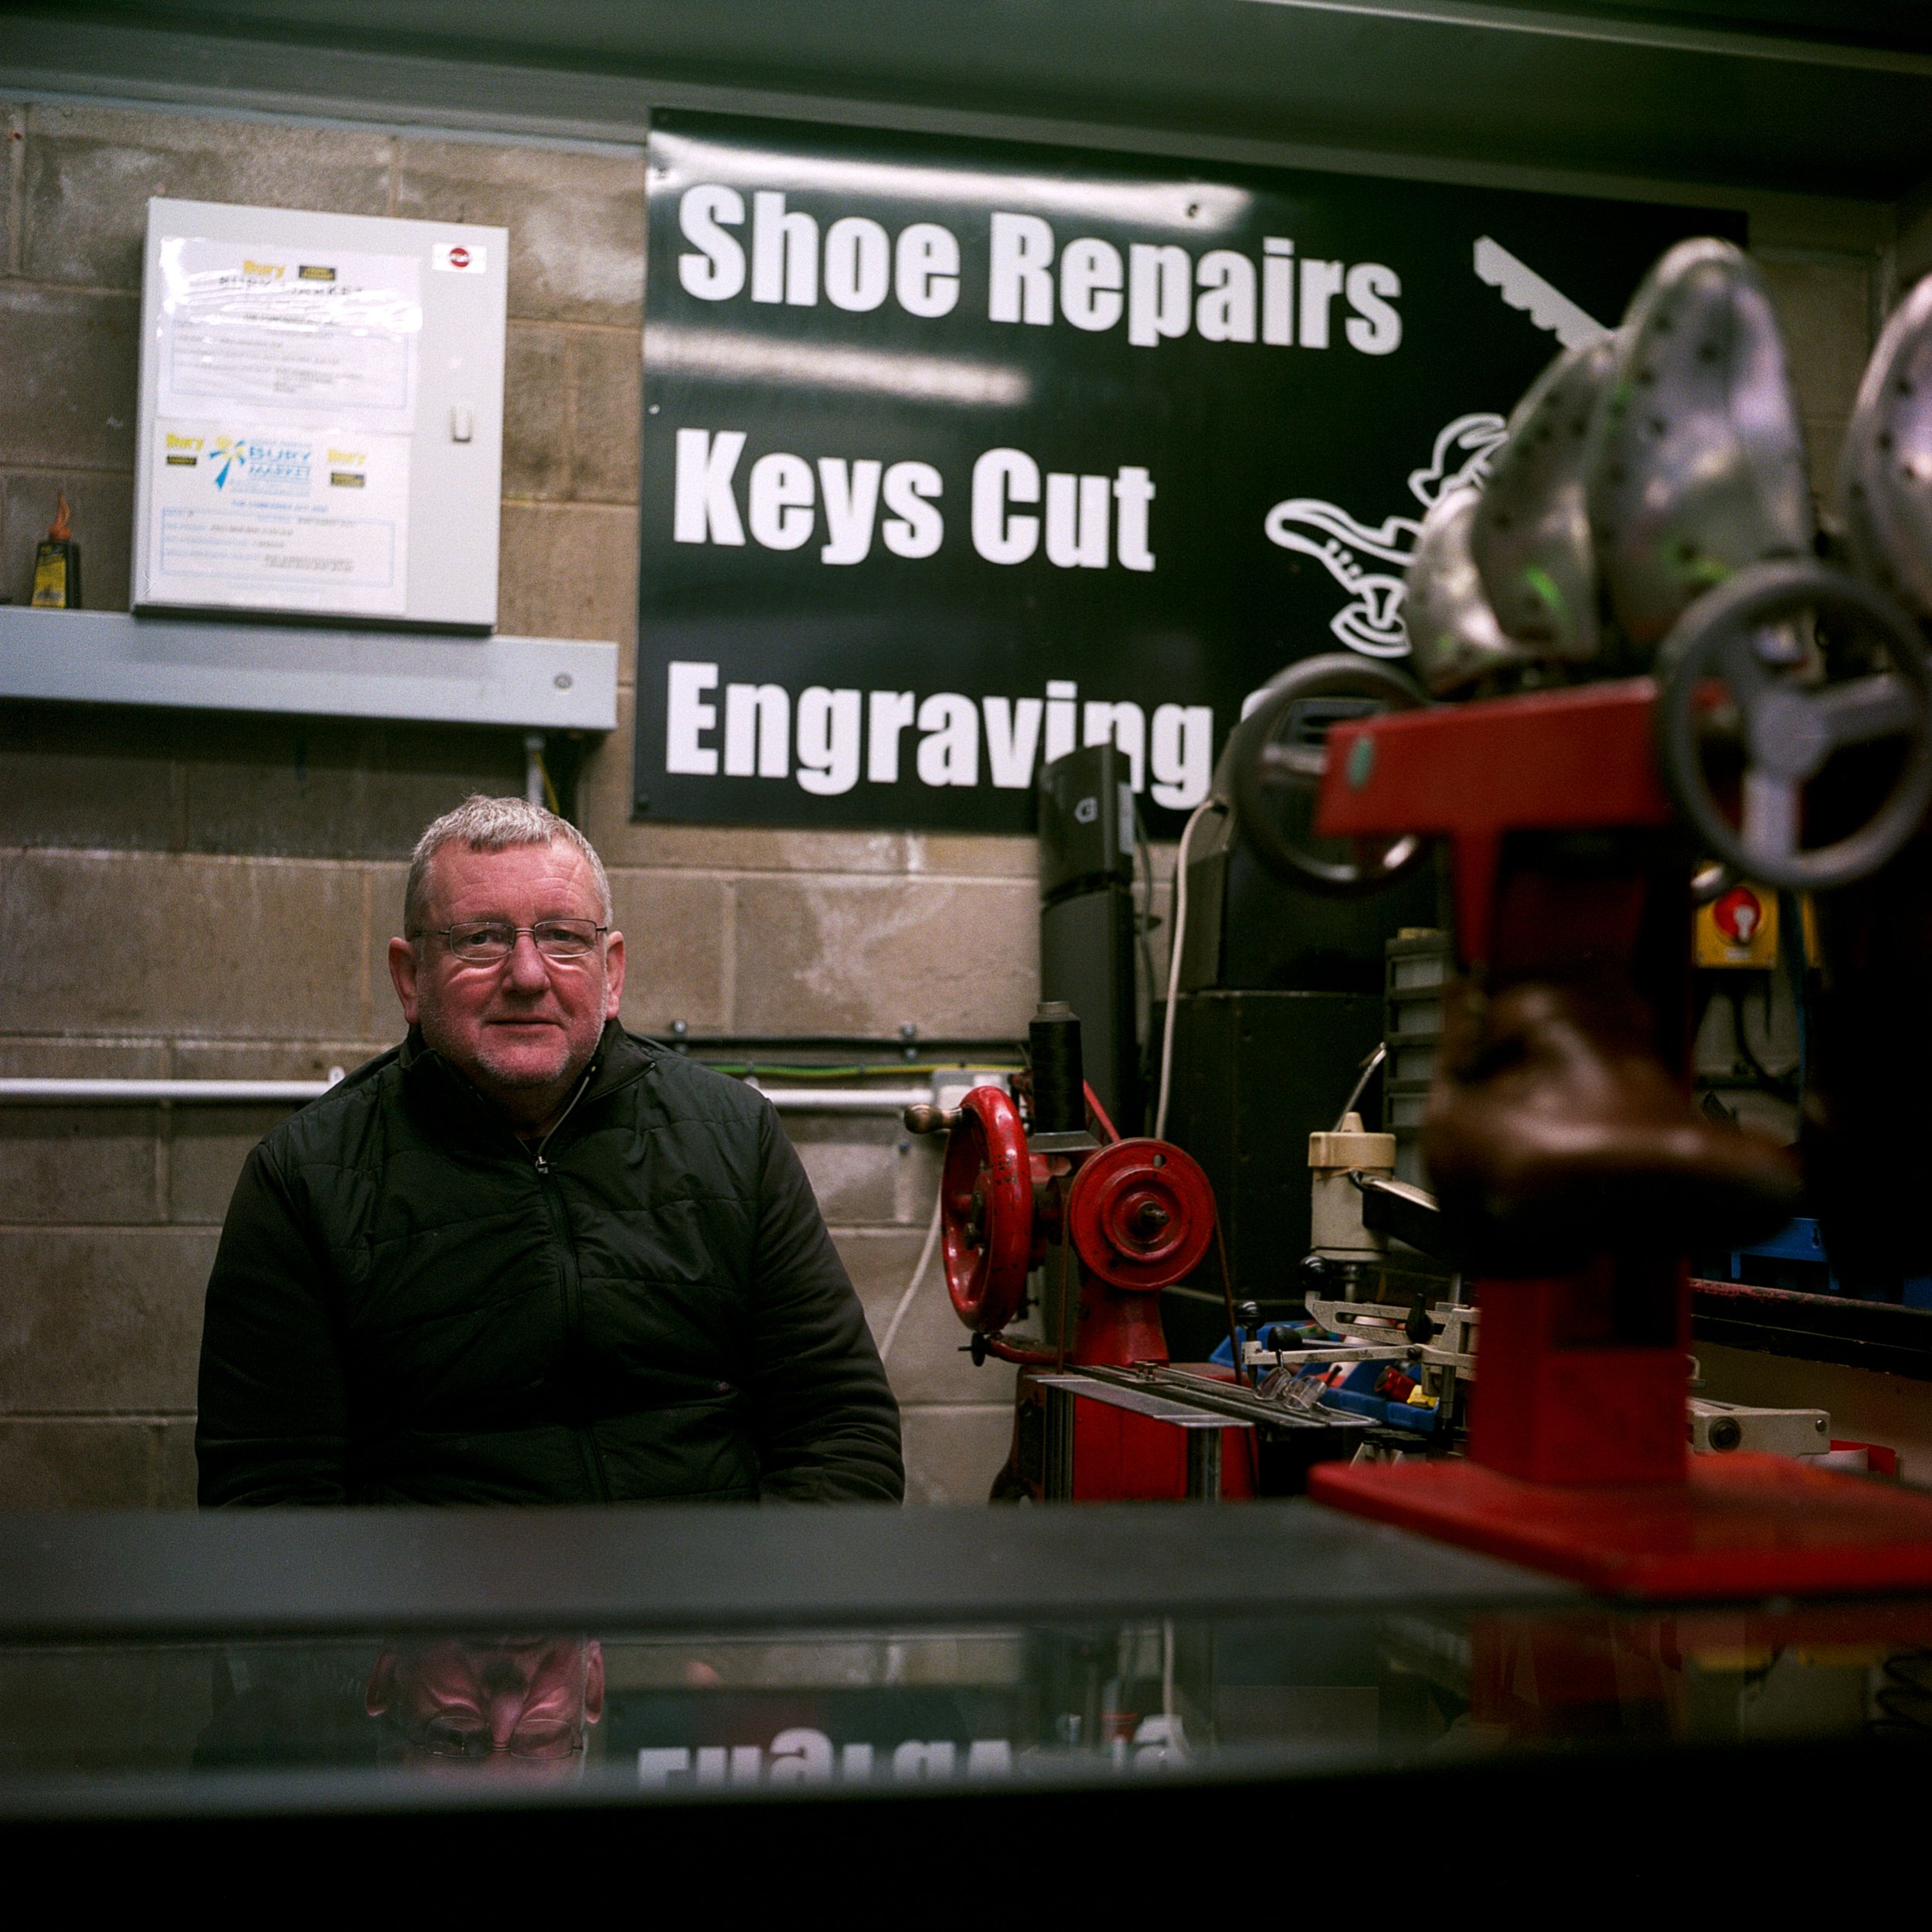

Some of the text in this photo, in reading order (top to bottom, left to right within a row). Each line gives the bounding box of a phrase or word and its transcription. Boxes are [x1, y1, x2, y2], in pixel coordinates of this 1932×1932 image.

[678, 183, 1403, 355] Shoe Repairs
[673, 428, 1156, 572] Keys Cut
[665, 661, 1214, 810] Engraving
